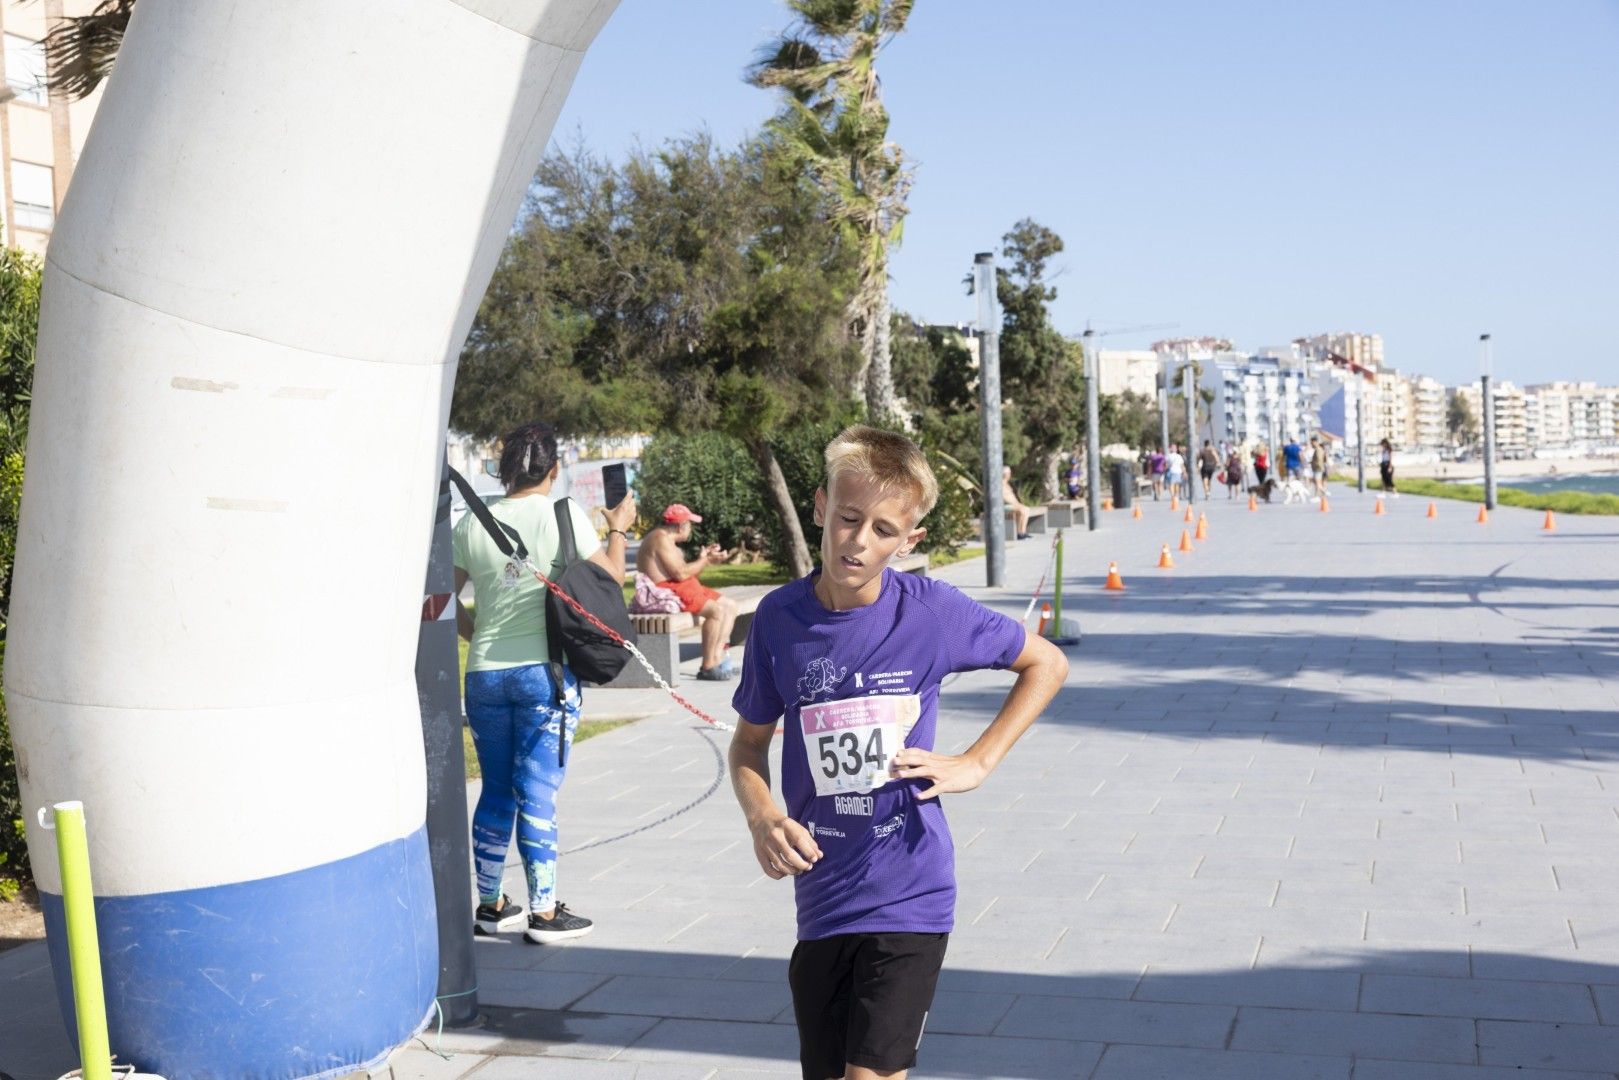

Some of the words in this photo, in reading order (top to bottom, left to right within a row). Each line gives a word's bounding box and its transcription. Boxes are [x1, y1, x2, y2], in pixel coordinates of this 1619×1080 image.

[819, 728, 887, 778] 534
[834, 796, 874, 816] AGAMED
[816, 829, 846, 838] TORREVIEJA
